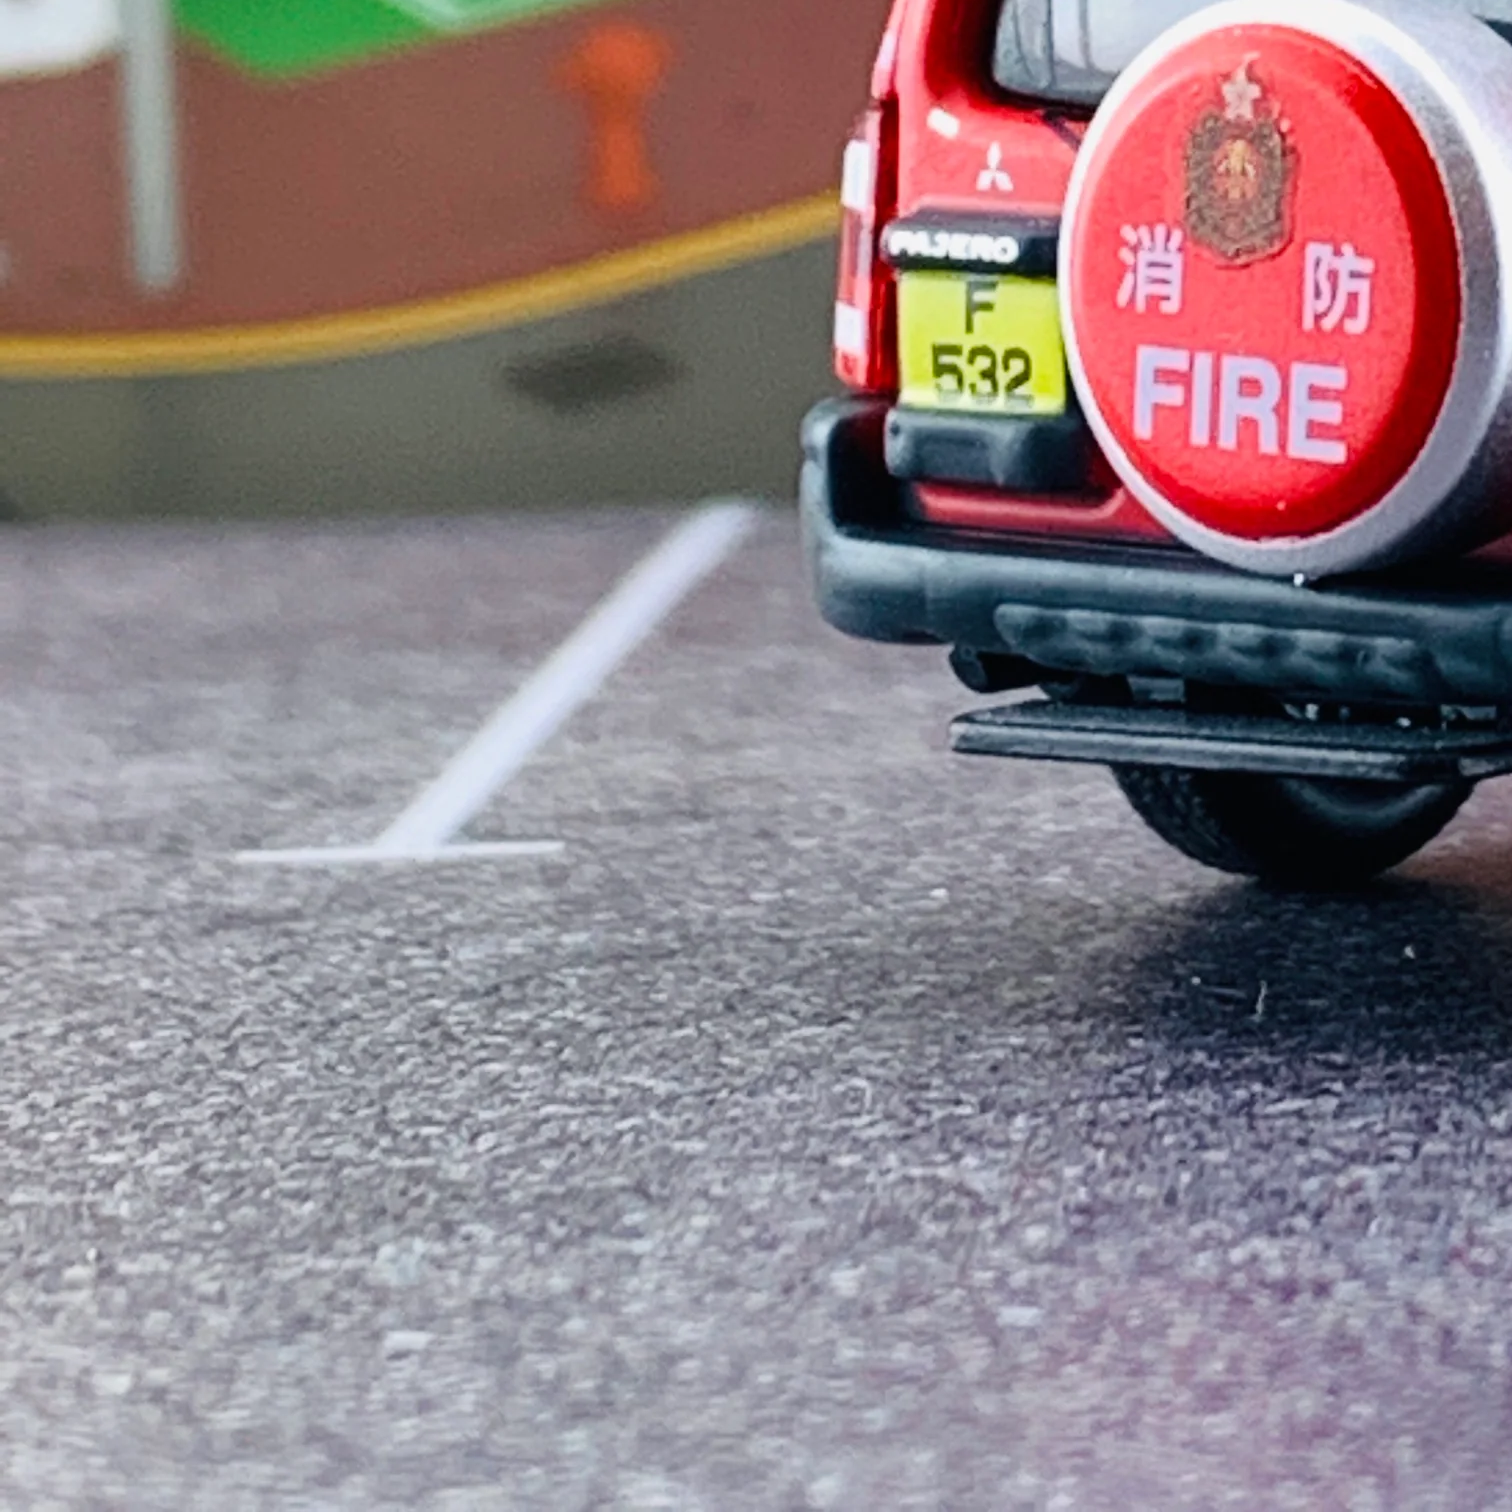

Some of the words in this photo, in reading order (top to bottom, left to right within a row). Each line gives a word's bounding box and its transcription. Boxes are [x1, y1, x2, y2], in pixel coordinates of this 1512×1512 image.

[888, 229, 1020, 264] PAJERO
[964, 280, 998, 335] F
[1115, 223, 1185, 314] 消
[1302, 240, 1375, 335] 防
[931, 343, 1035, 407] 532
[1132, 343, 1349, 465] FIRE
